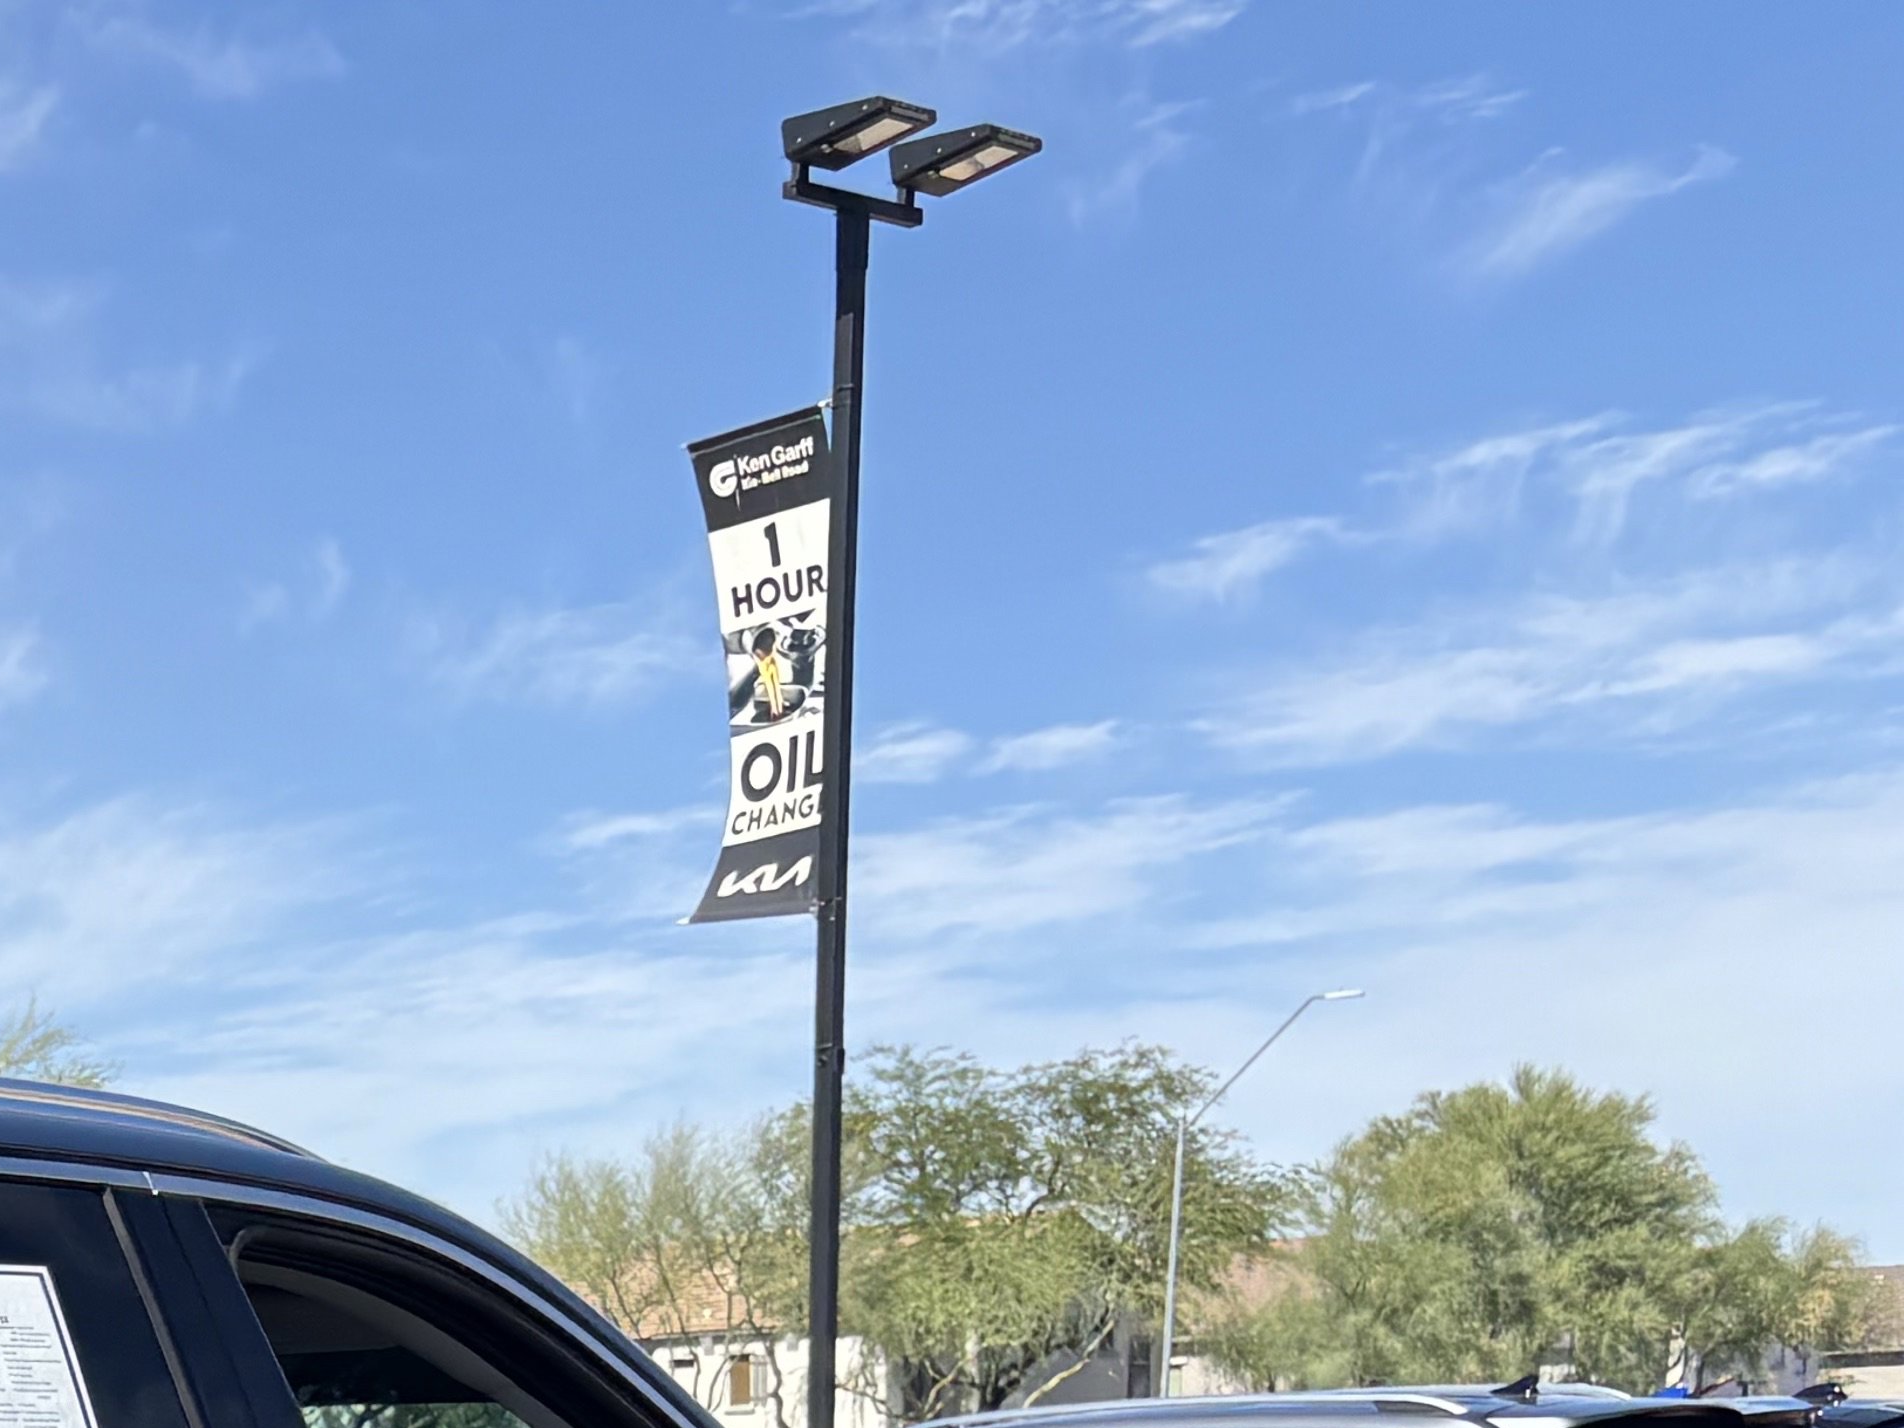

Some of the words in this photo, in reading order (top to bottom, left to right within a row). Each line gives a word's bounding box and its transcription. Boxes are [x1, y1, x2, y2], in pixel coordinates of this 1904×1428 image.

[737, 455, 771, 475] Ken
[771, 436, 814, 465] Garff
[763, 521, 781, 568] 1
[731, 564, 825, 618] HOUR
[741, 730, 823, 802] OIL
[732, 793, 822, 836] CHANG
[717, 855, 813, 897] KIA
